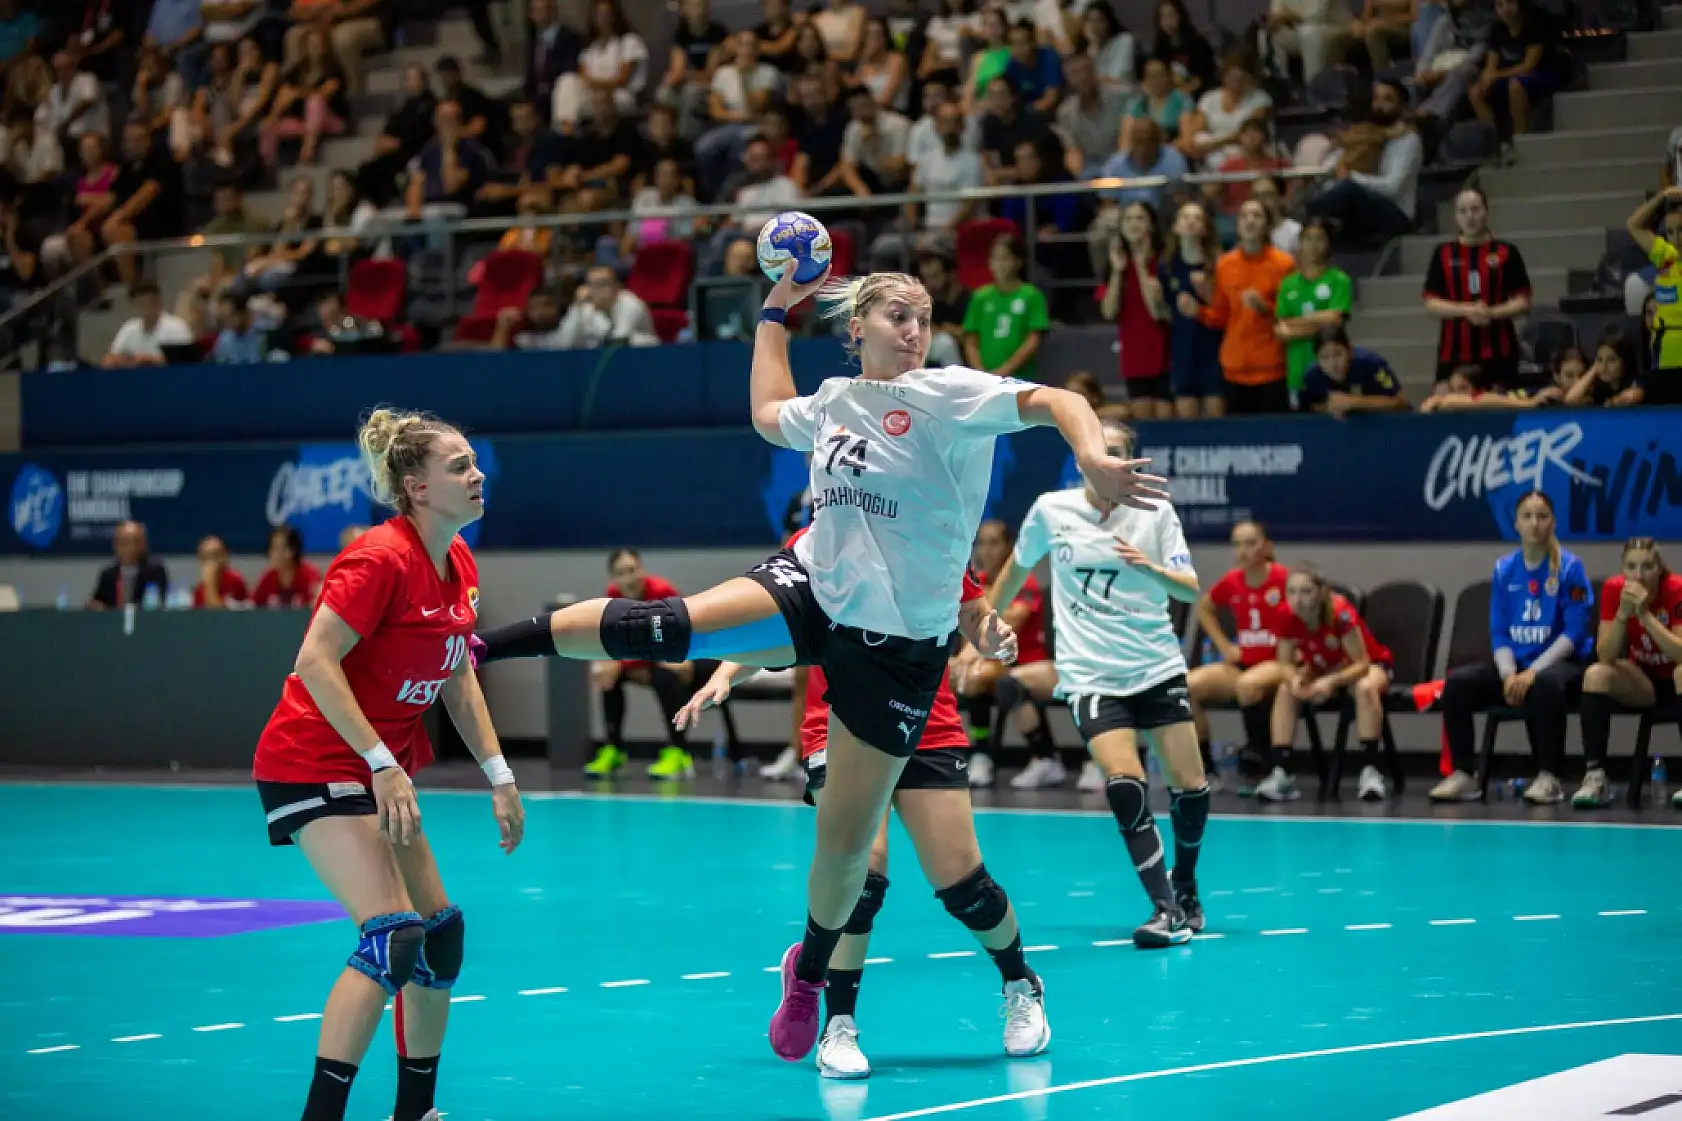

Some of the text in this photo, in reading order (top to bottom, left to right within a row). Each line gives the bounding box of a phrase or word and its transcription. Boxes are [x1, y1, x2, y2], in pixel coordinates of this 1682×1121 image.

[825, 434, 868, 477] 74
[1424, 421, 1603, 511] CHEER
[1075, 567, 1119, 600] 77
[440, 635, 466, 671] 10
